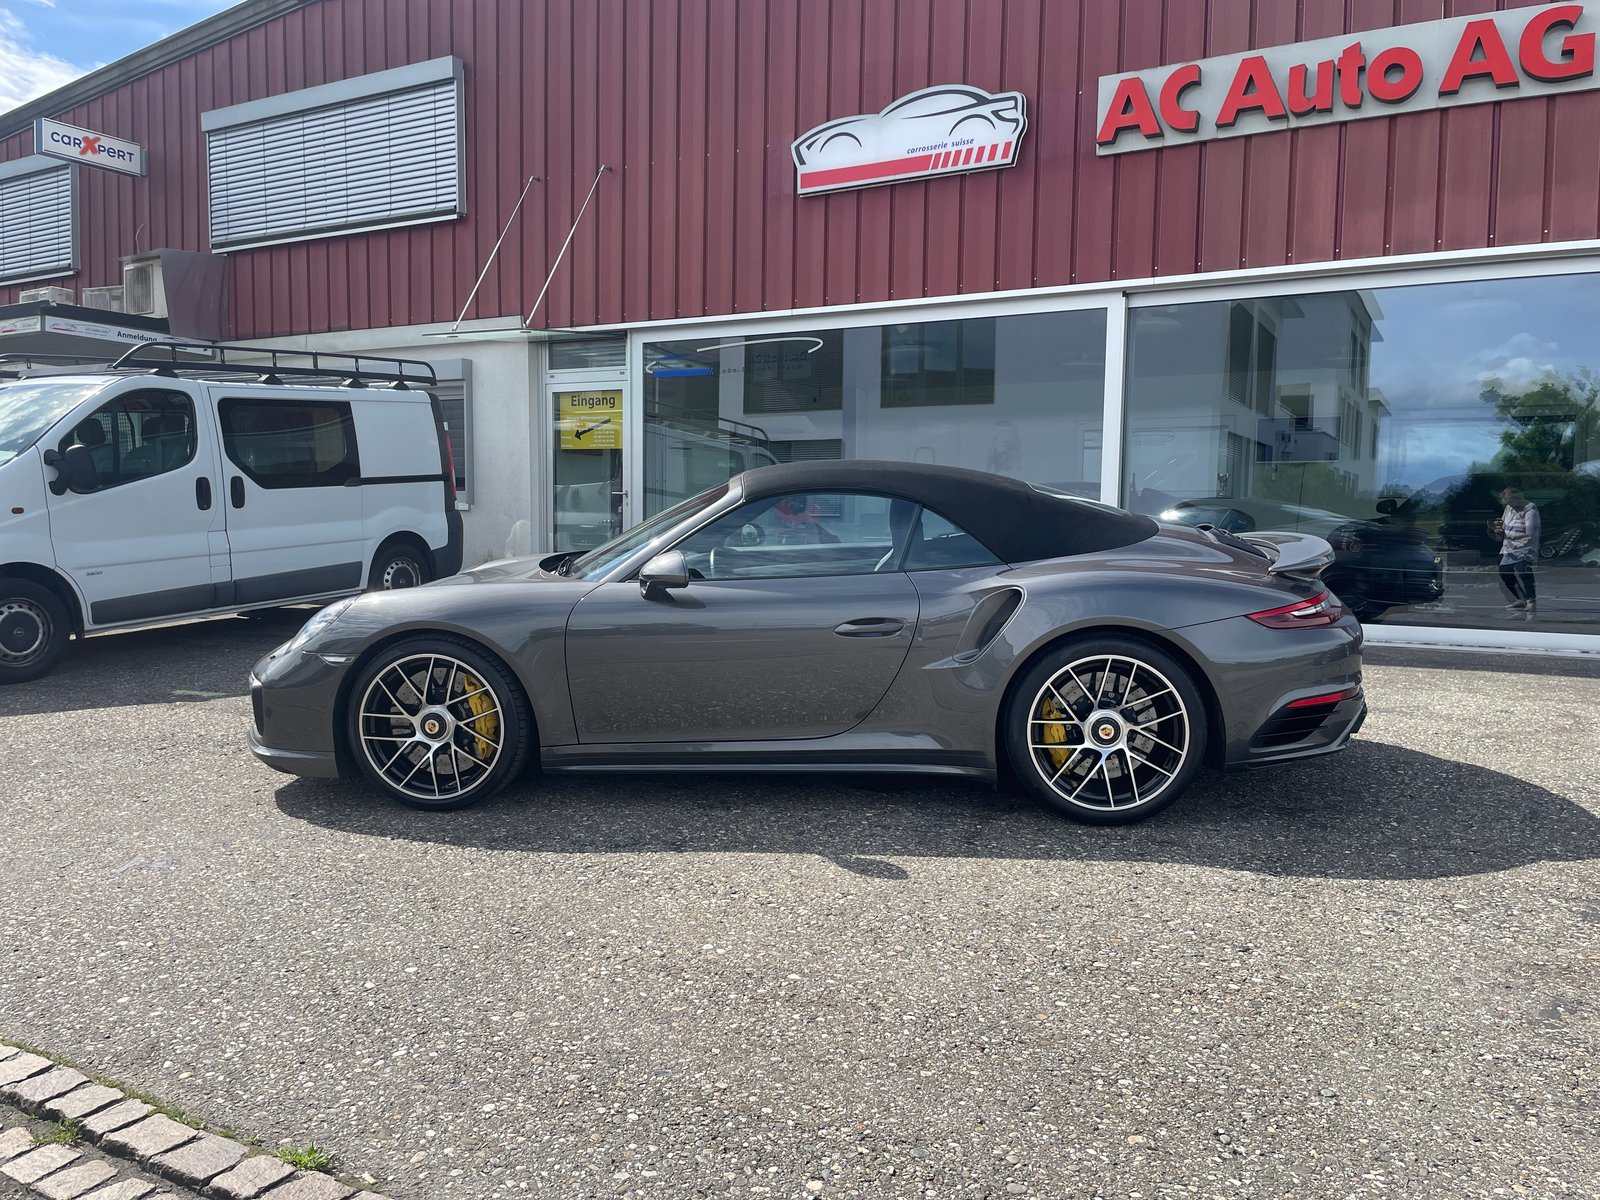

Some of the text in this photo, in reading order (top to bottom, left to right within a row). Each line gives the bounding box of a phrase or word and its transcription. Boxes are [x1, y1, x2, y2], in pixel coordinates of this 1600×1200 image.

[1096, 5, 1596, 146] AC Auto AG
[906, 138, 975, 154] carrosserie suisse
[571, 395, 616, 409] Eingang
